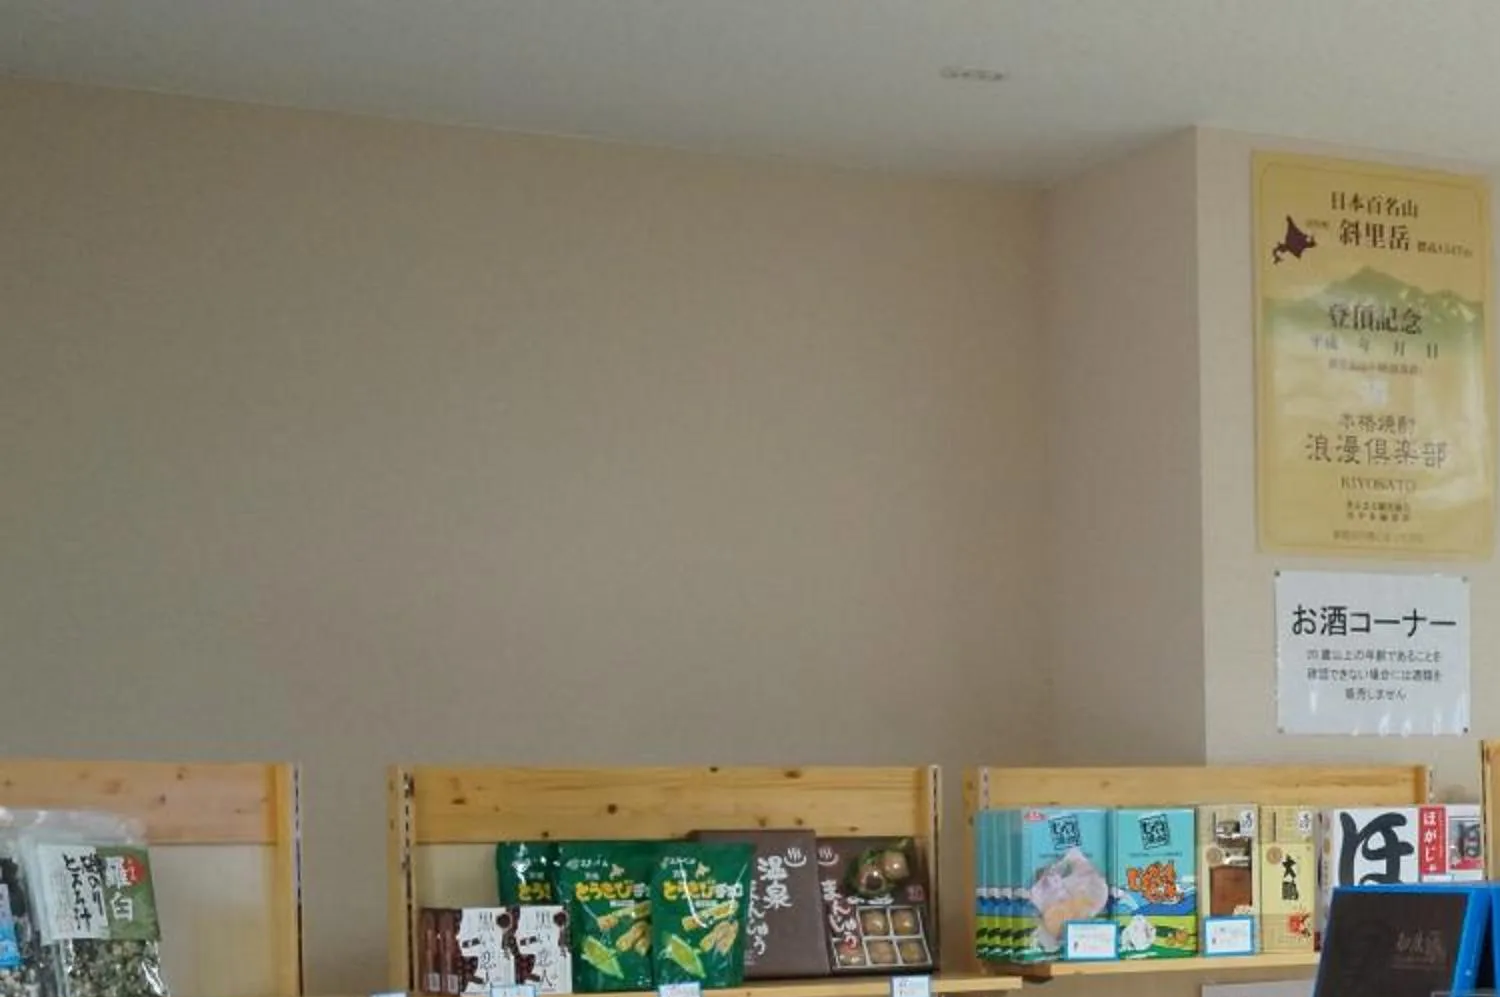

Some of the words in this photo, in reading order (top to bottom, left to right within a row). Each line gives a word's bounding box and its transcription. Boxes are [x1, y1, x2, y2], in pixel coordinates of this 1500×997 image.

[1331, 191, 1418, 218] 日本百名山
[1339, 218, 1409, 251] 斜里岳
[1329, 303, 1422, 335] 登頂記念
[1304, 434, 1448, 468] 浪漫倶楽部
[1292, 603, 1457, 637] お酒コーナー
[757, 855, 793, 909] 温泉
